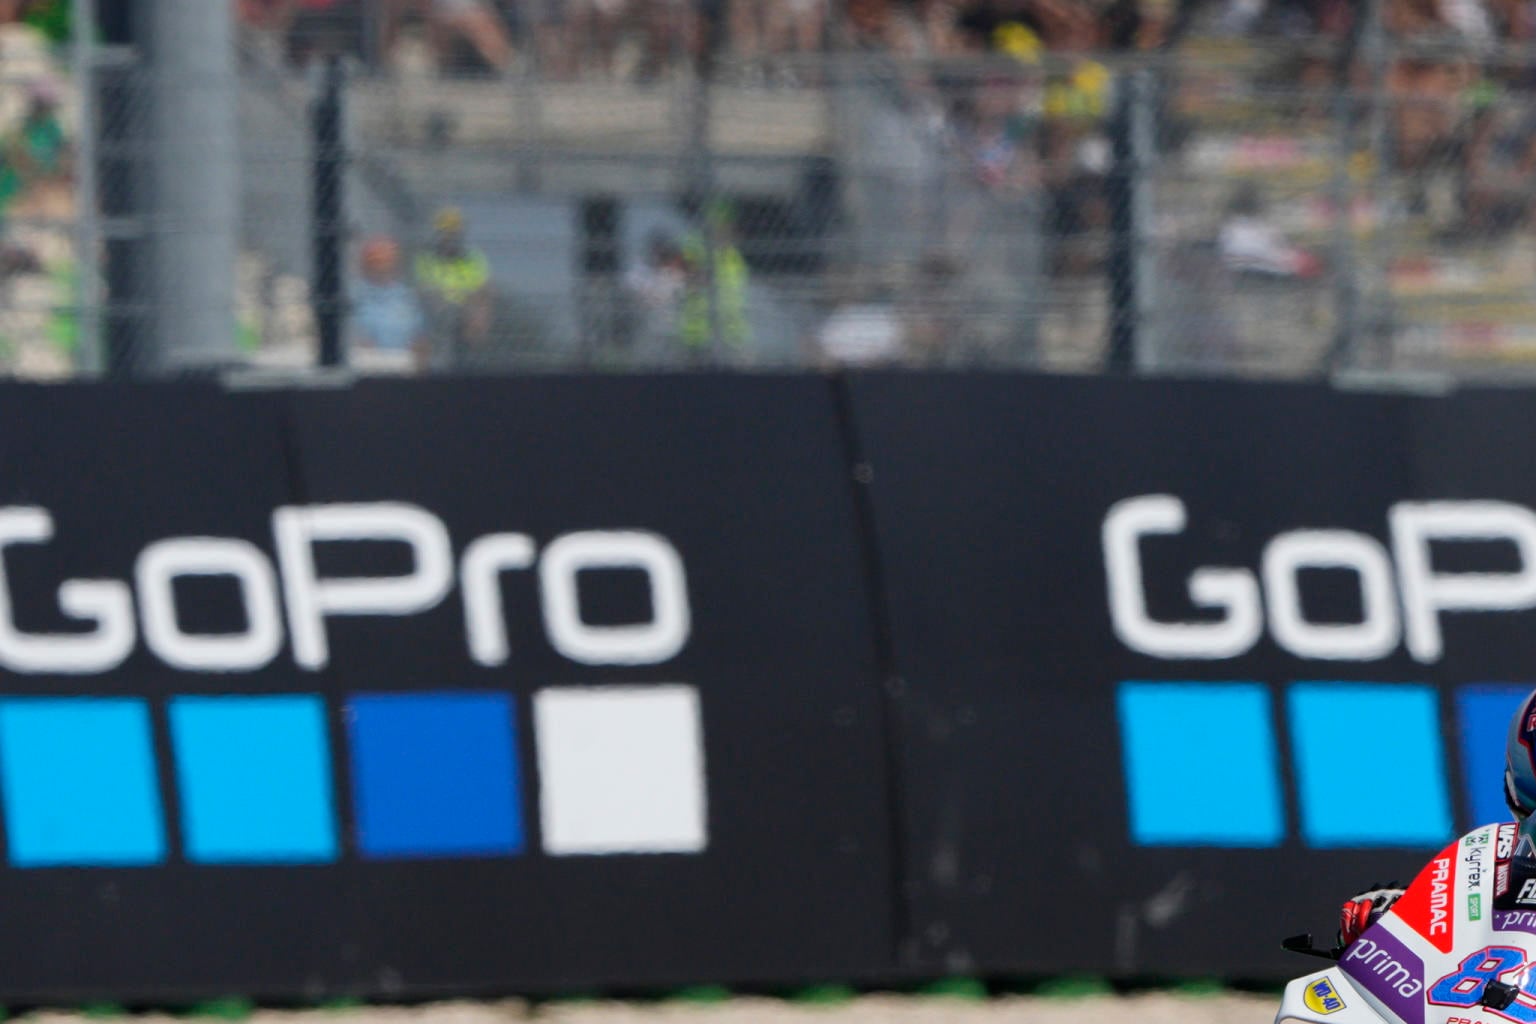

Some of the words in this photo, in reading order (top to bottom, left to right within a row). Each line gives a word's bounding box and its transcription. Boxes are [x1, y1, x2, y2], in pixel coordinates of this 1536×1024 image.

[0, 501, 691, 674] GoPro
[1496, 823, 1516, 860] WRS
[1465, 846, 1486, 890] kyrrex
[1430, 857, 1450, 936] PRAMAC
[1345, 938, 1423, 999] prima
[1312, 979, 1341, 1011] WD-40
